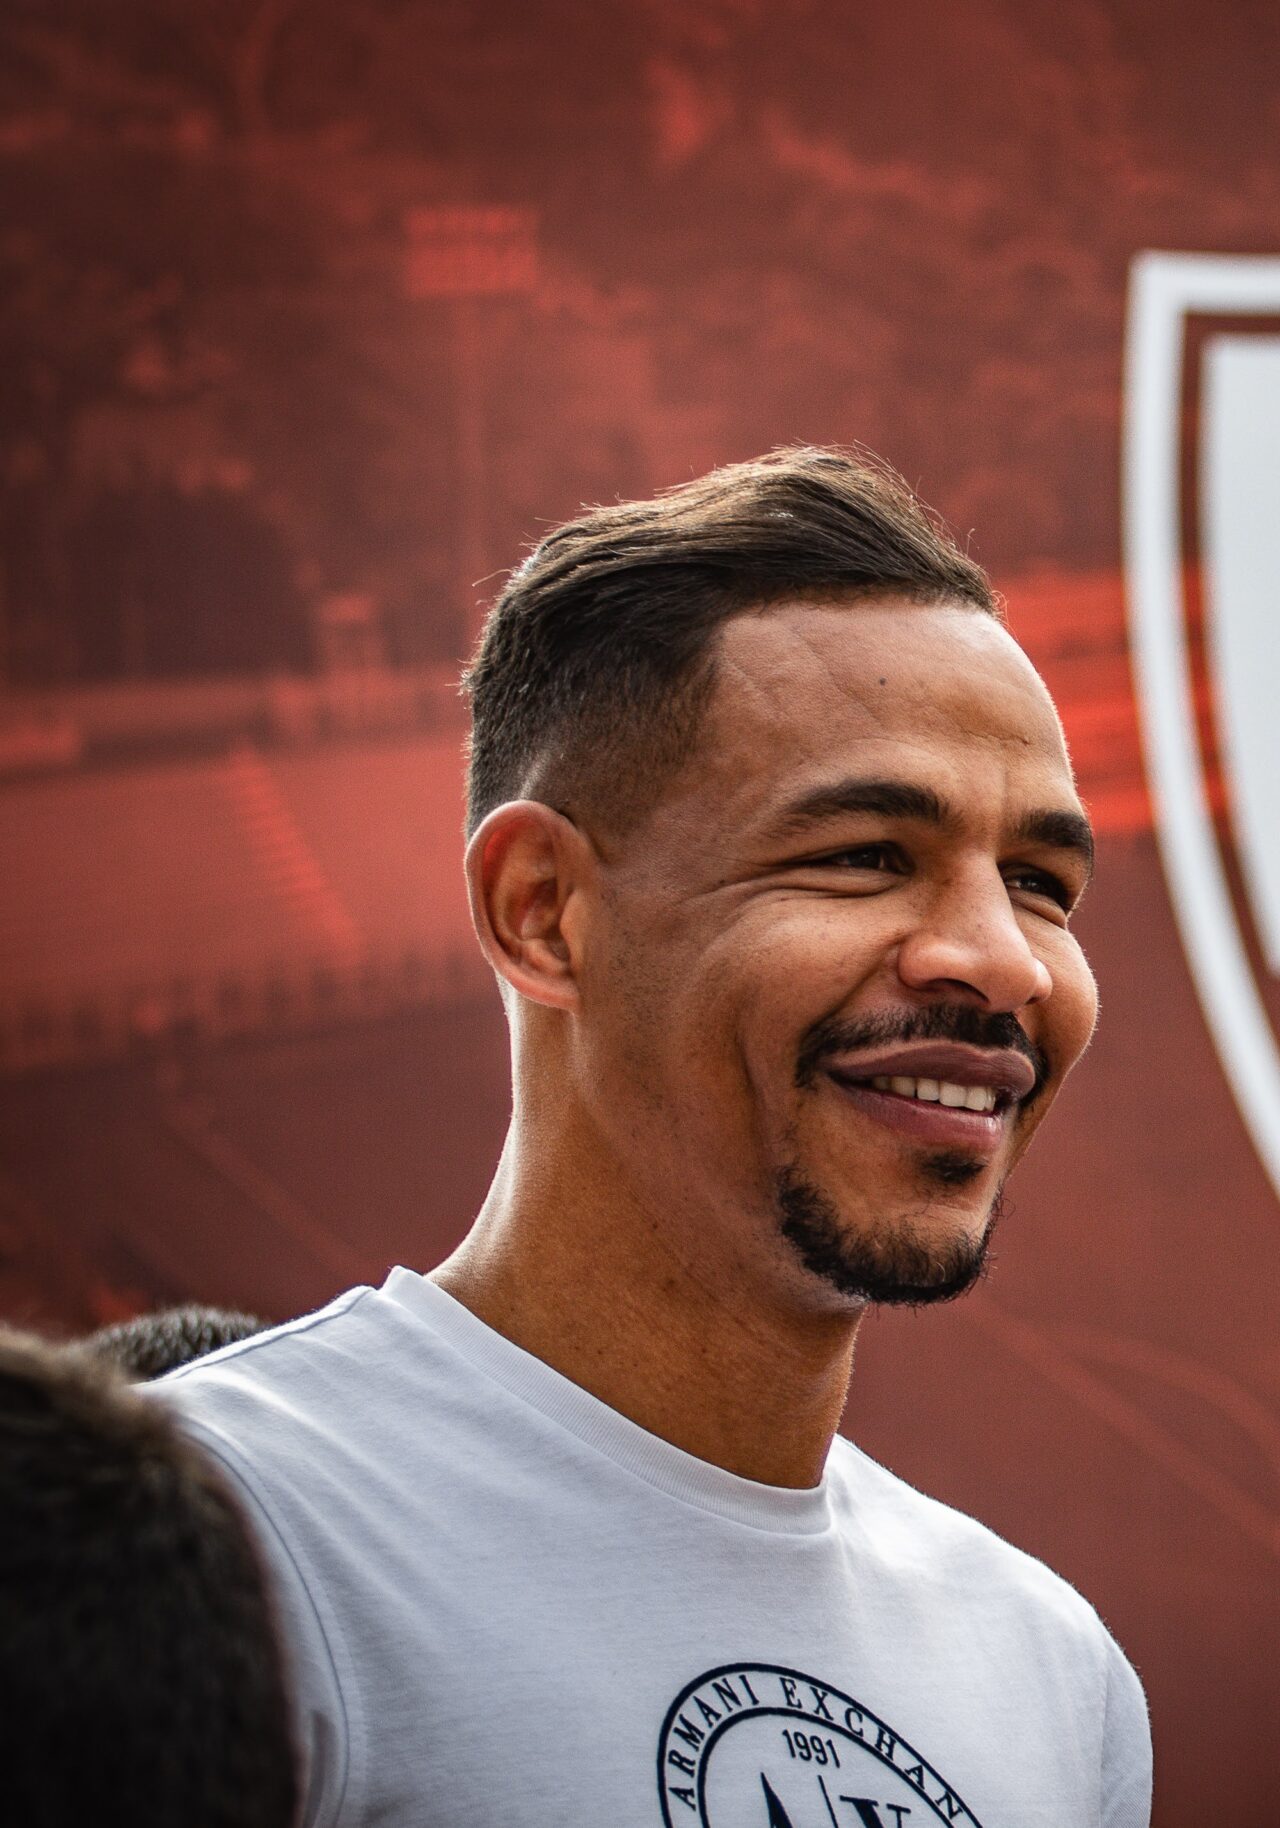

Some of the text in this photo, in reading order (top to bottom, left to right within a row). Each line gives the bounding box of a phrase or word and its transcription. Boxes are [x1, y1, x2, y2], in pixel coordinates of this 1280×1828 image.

[668, 1675, 760, 1811] ARMANI
[780, 1677, 963, 1819] EXCHAN
[782, 1729, 841, 1769] 1991
